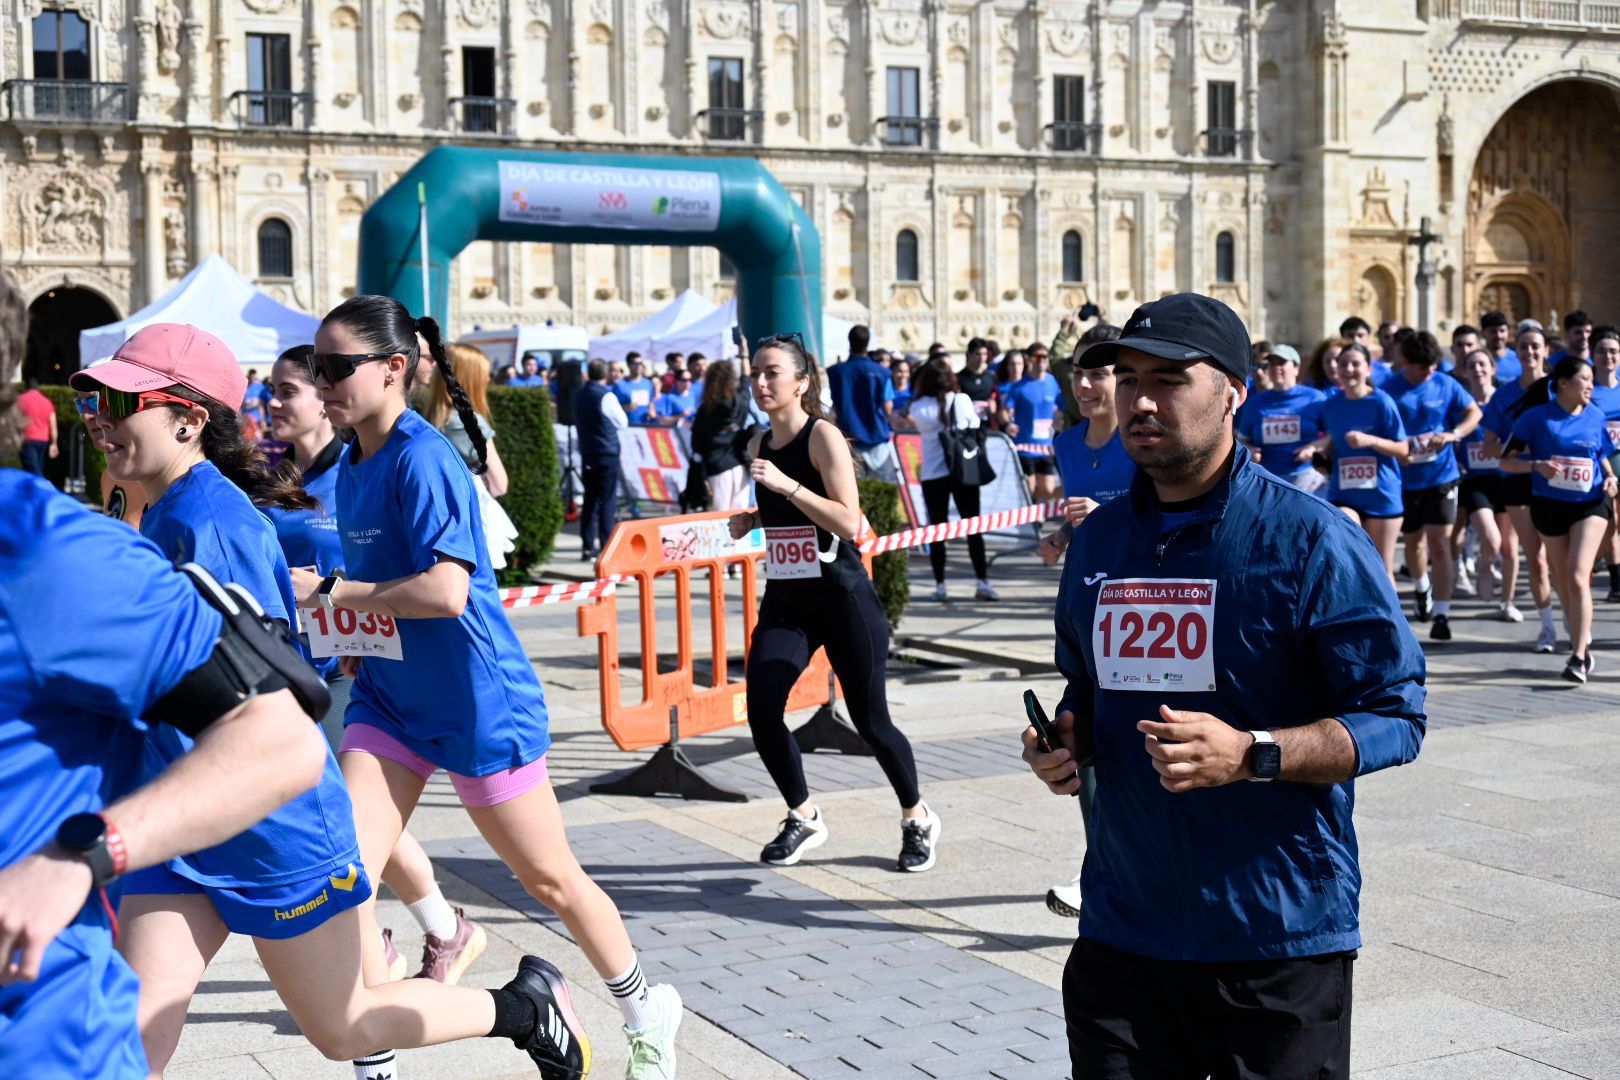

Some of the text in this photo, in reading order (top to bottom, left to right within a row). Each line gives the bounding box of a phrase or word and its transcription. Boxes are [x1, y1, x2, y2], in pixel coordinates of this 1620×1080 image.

[543, 168, 567, 182] DE
[569, 169, 649, 188] CASTILLA
[649, 174, 663, 188] Y
[666, 174, 713, 191] LEÓN
[671, 196, 710, 211] Plena
[1265, 423, 1299, 436] 1143
[364, 527, 382, 536] LEÓN
[768, 541, 816, 564] 1096
[1103, 587, 1208, 599] DÍA DE CASTILLA Y LEÓN
[311, 607, 395, 637] 1039
[1099, 611, 1207, 660] 1220
[274, 888, 329, 921] hummel
